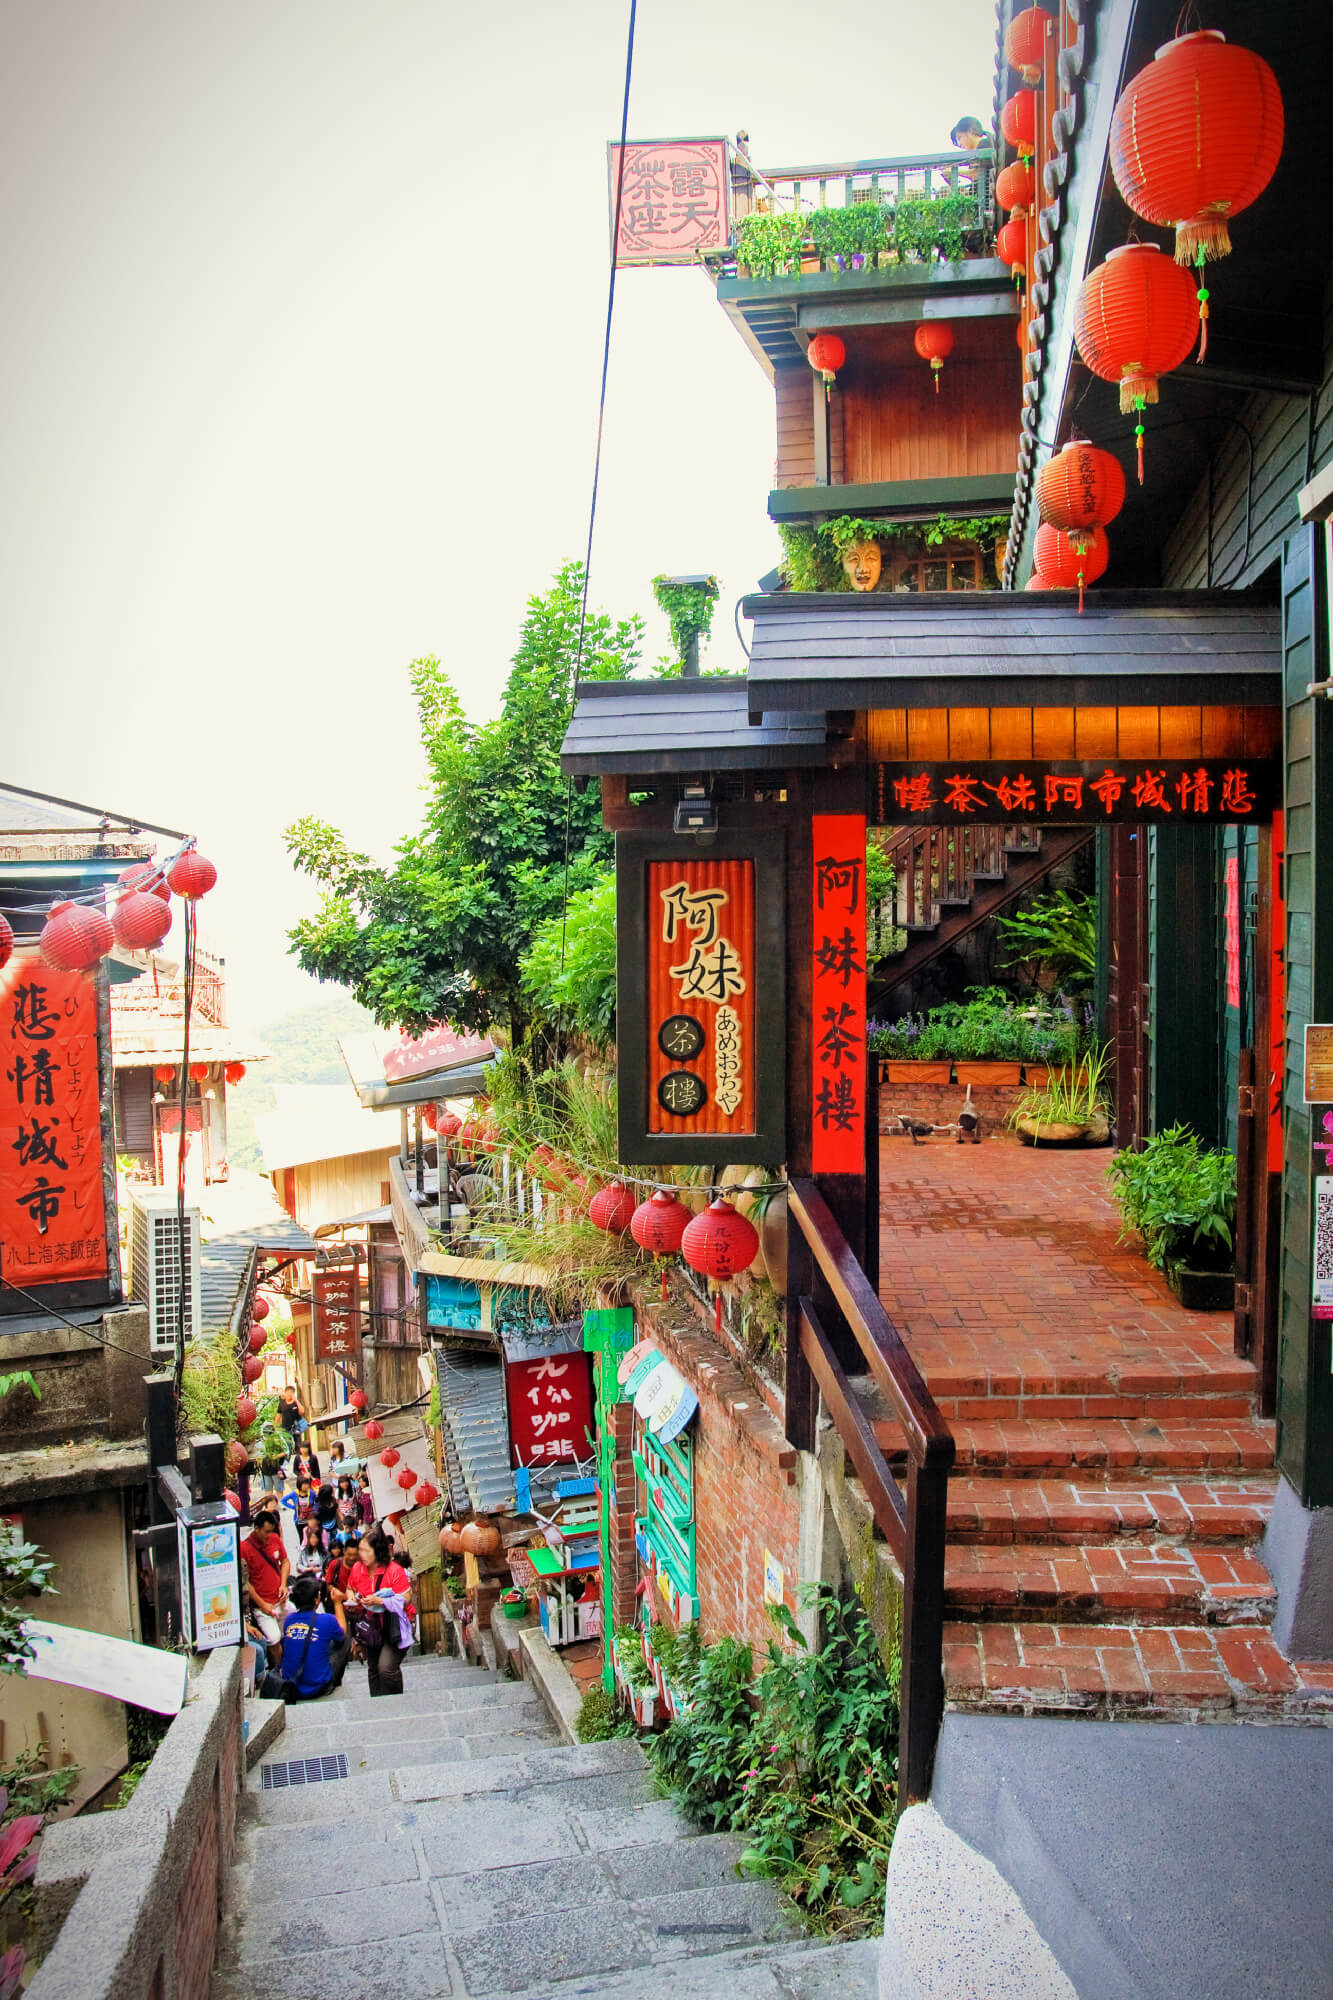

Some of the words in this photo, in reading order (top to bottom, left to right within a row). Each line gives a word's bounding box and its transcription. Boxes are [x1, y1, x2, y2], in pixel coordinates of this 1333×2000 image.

[893, 768, 1256, 813] 悲情城市阿妹茶樓
[663, 886, 742, 1000] 阿妹
[814, 856, 866, 1133] 阿妹茶樓
[7, 982, 68, 1234] 悲情城市
[665, 1021, 699, 1109] 茶樓
[7, 1239, 101, 1266] 小上海茶飯館
[527, 1357, 574, 1456] 九份咖啡
